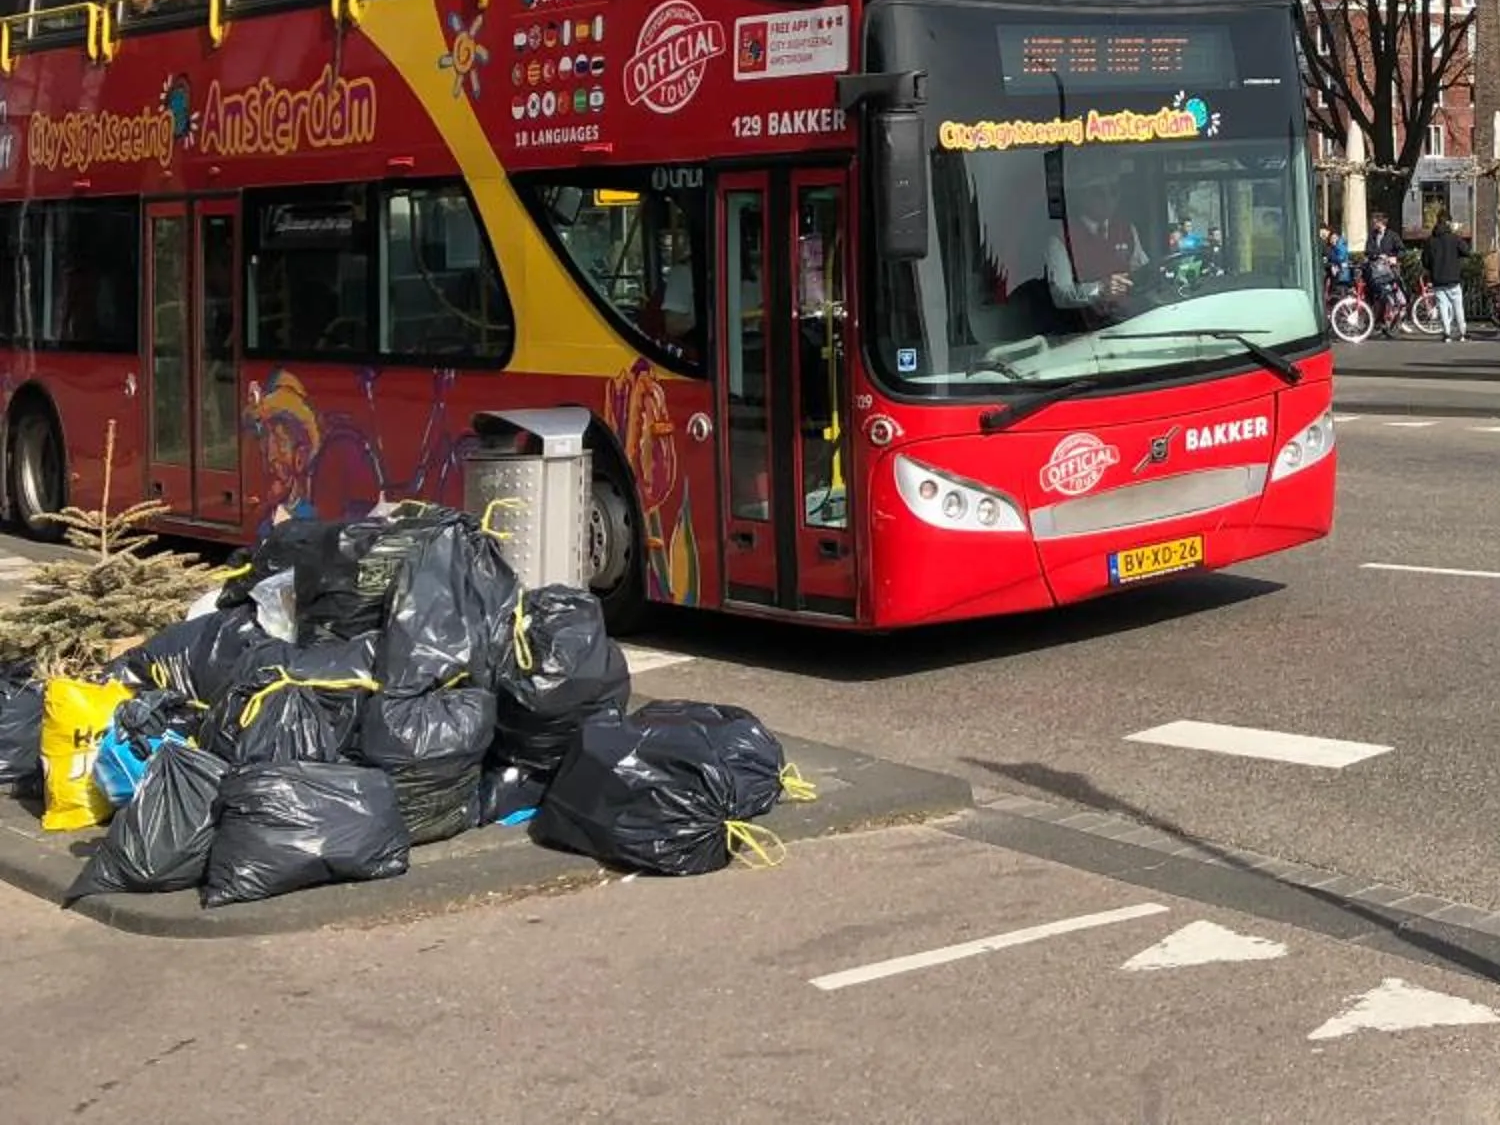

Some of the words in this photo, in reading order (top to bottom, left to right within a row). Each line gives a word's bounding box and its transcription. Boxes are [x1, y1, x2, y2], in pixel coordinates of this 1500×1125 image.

[769, 22, 789, 34] FREE
[791, 19, 808, 31] APP
[633, 26, 720, 92] OFFICIAL
[660, 68, 699, 104] TOUR
[200, 63, 377, 155] Amsterdam
[731, 114, 761, 137] 129
[767, 108, 846, 136] BAKKER
[1086, 107, 1199, 141] Amsterdam
[515, 131, 527, 147] 18
[531, 125, 599, 146] LANGUAGES
[1185, 416, 1269, 451] BAKKER
[1047, 448, 1117, 484] OFFICIAL
[1124, 540, 1198, 572] BV-XD-26
